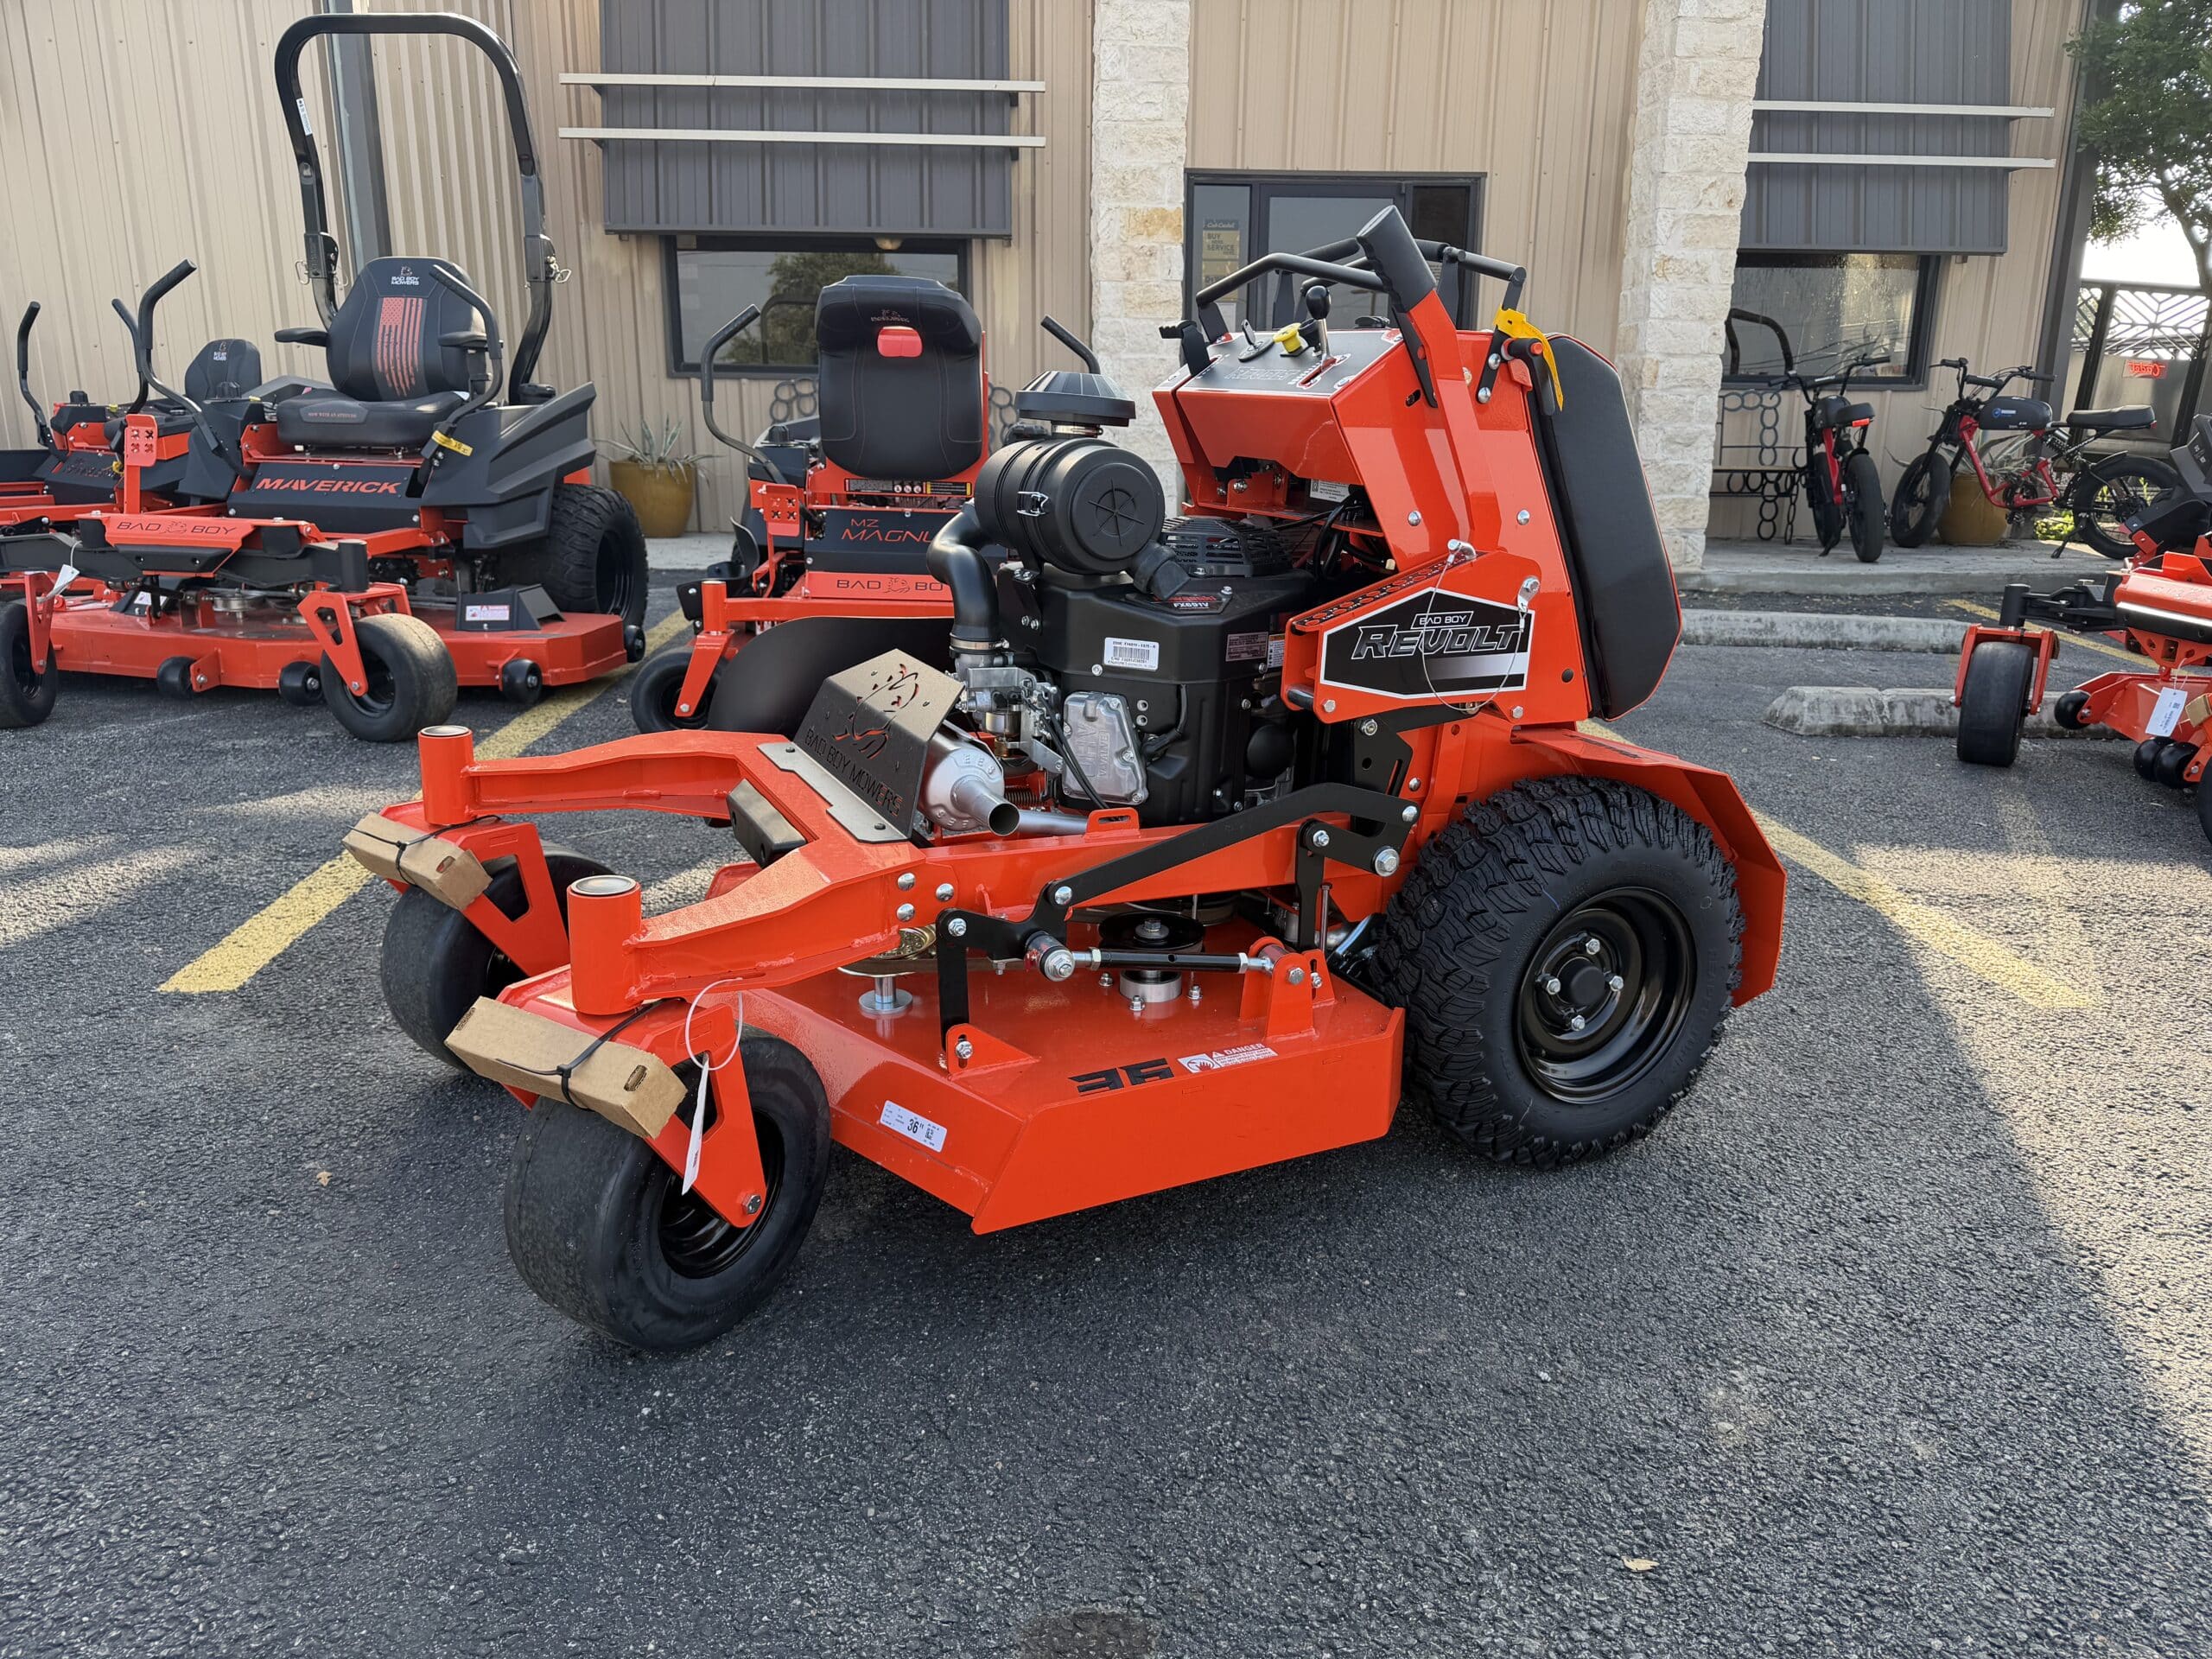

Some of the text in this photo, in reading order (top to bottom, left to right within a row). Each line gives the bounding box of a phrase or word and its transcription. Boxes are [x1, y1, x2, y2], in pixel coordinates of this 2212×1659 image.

[256, 478, 402, 493] MAVERICK
[117, 521, 238, 535] BAD BOY
[850, 518, 879, 528] MZ
[836, 579, 944, 591] BAD BO
[1419, 614, 1467, 626] BAD BOY
[804, 728, 904, 817] BAD BOY MOWERS
[1224, 1043, 1266, 1054] DANGER
[1066, 1058, 1175, 1096] 36
